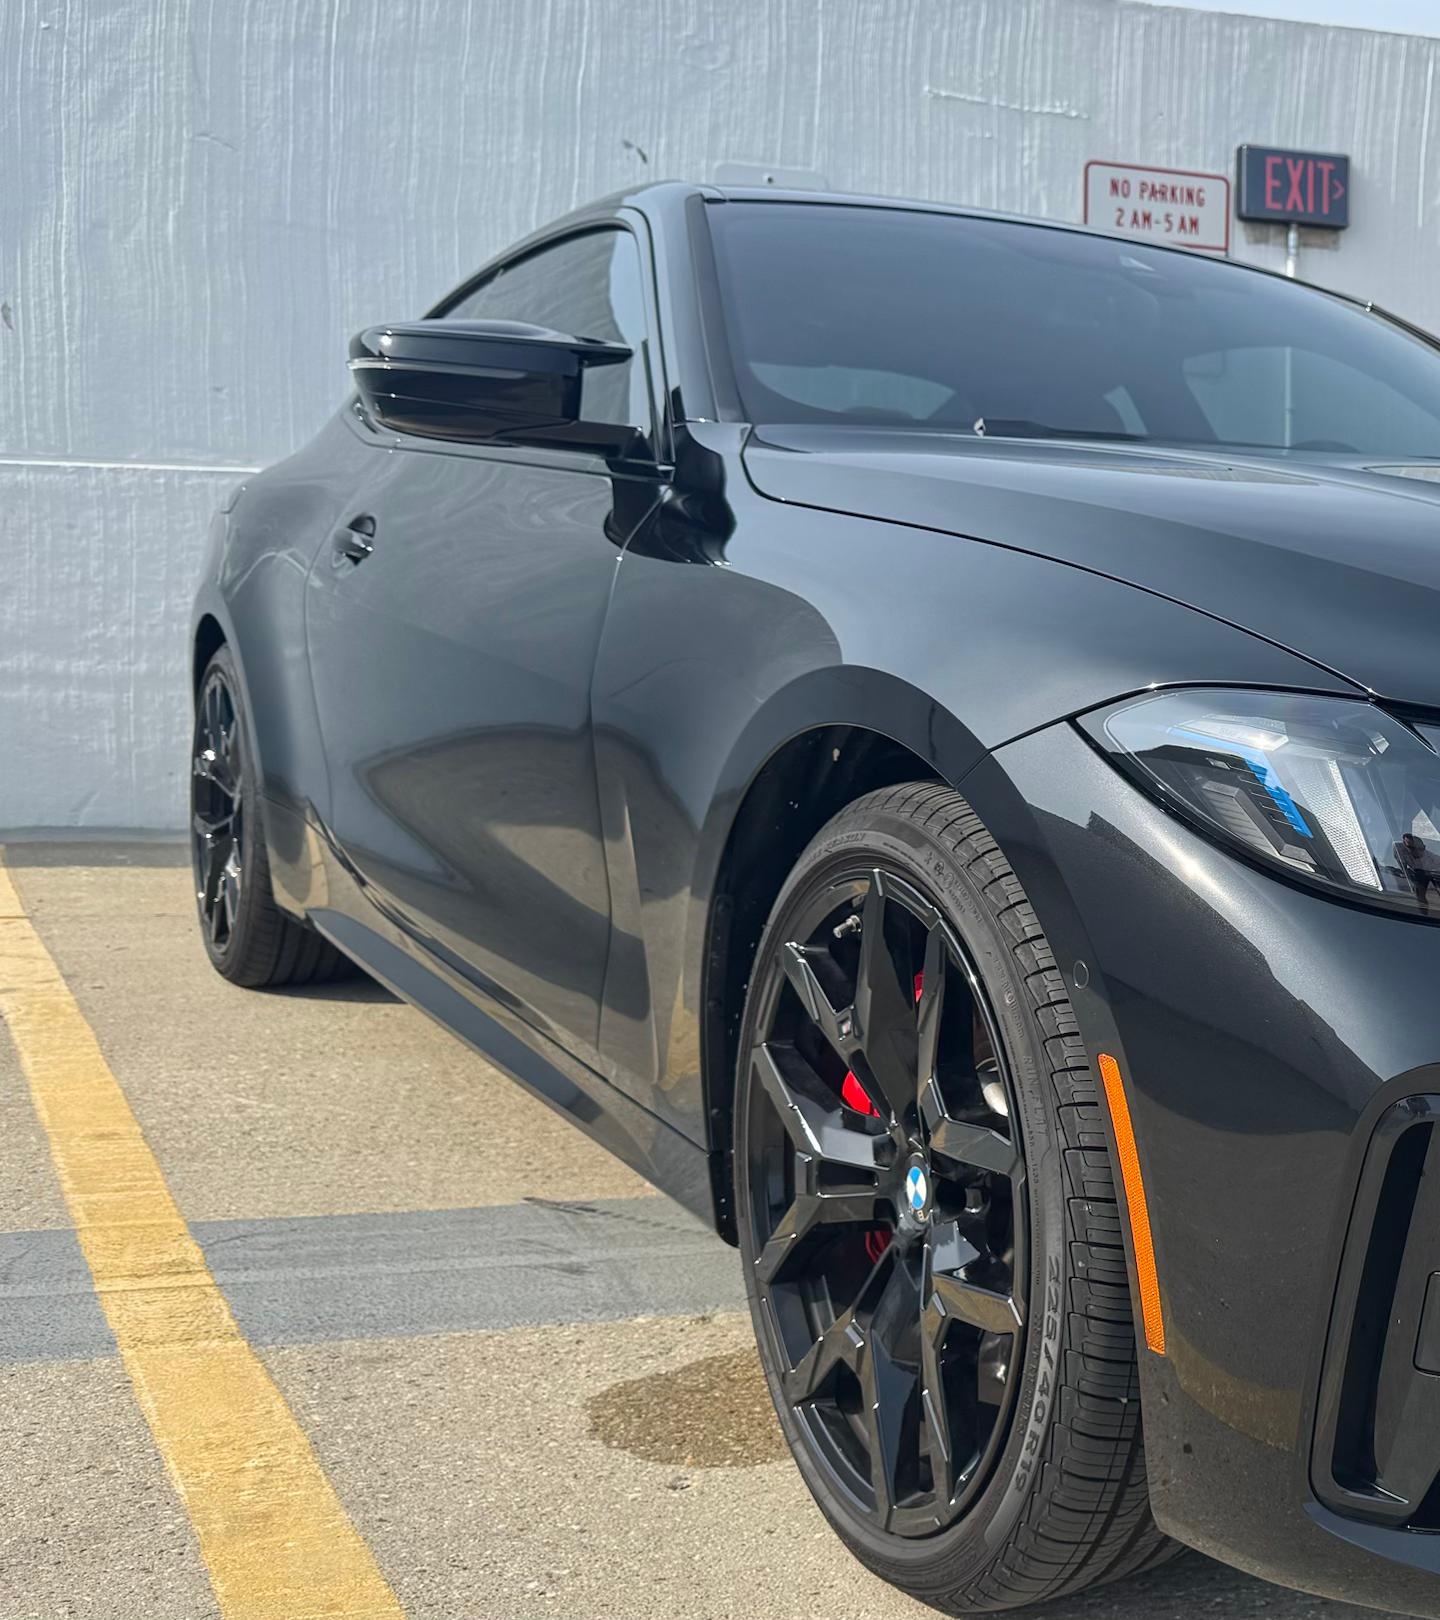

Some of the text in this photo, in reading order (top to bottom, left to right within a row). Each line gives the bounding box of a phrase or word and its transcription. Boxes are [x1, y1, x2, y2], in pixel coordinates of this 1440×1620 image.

[1110, 178, 1206, 207] NO PARKING
[1264, 155, 1336, 214] EXIT
[1115, 207, 1125, 227] 2
[1177, 215, 1200, 235] AM
